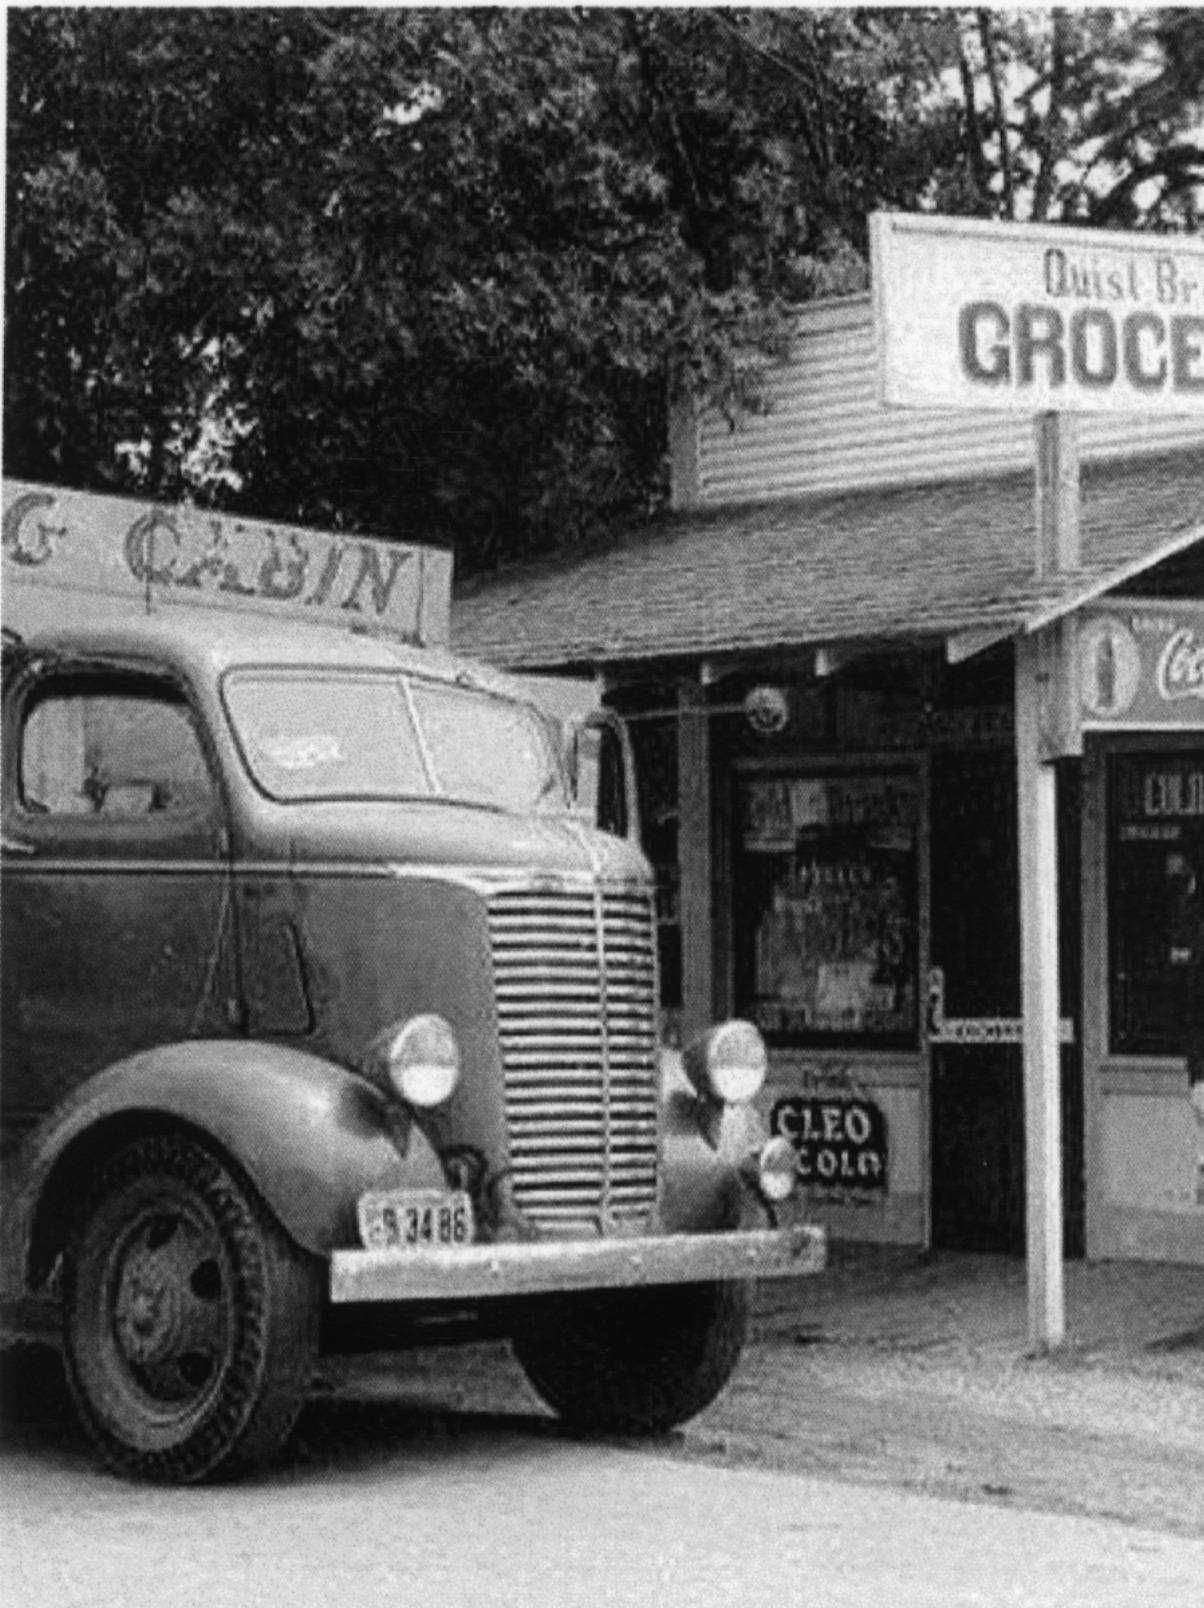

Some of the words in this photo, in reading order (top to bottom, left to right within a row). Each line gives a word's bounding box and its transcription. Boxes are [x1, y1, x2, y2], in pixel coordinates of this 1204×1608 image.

[123, 508, 412, 615] CABIN
[777, 1104, 872, 1145] CLEO
[797, 1147, 883, 1177] COLA
